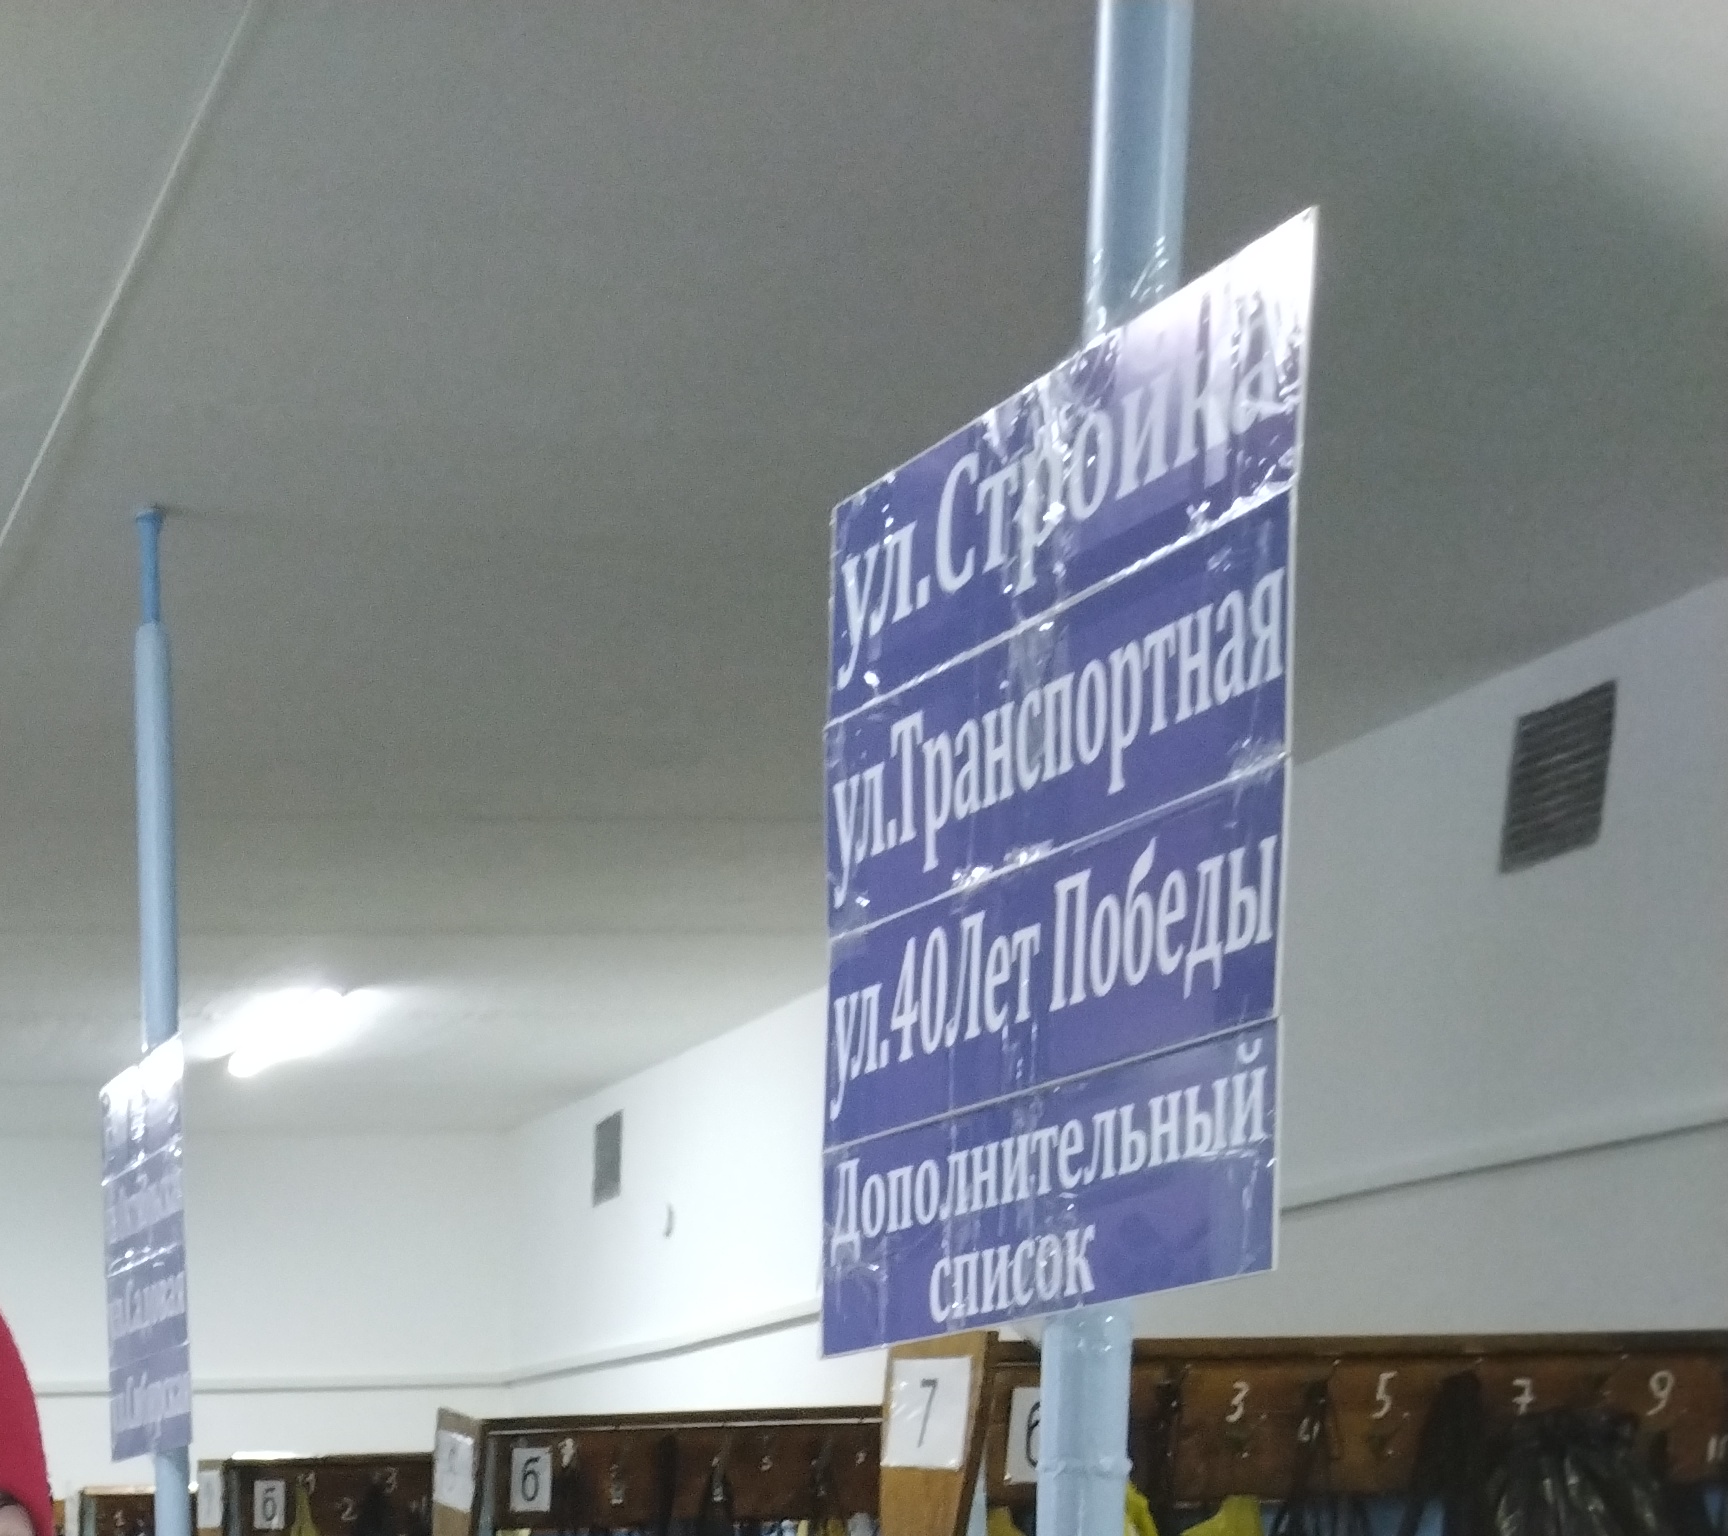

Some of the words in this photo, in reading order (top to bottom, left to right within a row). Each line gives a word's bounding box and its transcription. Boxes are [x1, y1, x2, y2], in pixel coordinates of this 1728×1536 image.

[832, 567, 1286, 908] ул.Транспортная
[1049, 835, 1278, 1012] Победы
[831, 1037, 1271, 1268] Дополнительный
[929, 1224, 1096, 1323] список
[919, 1377, 939, 1448] 7
[1225, 1381, 1250, 1423] 3
[1371, 1370, 1398, 1419] 5
[1646, 1369, 1676, 1416] 9
